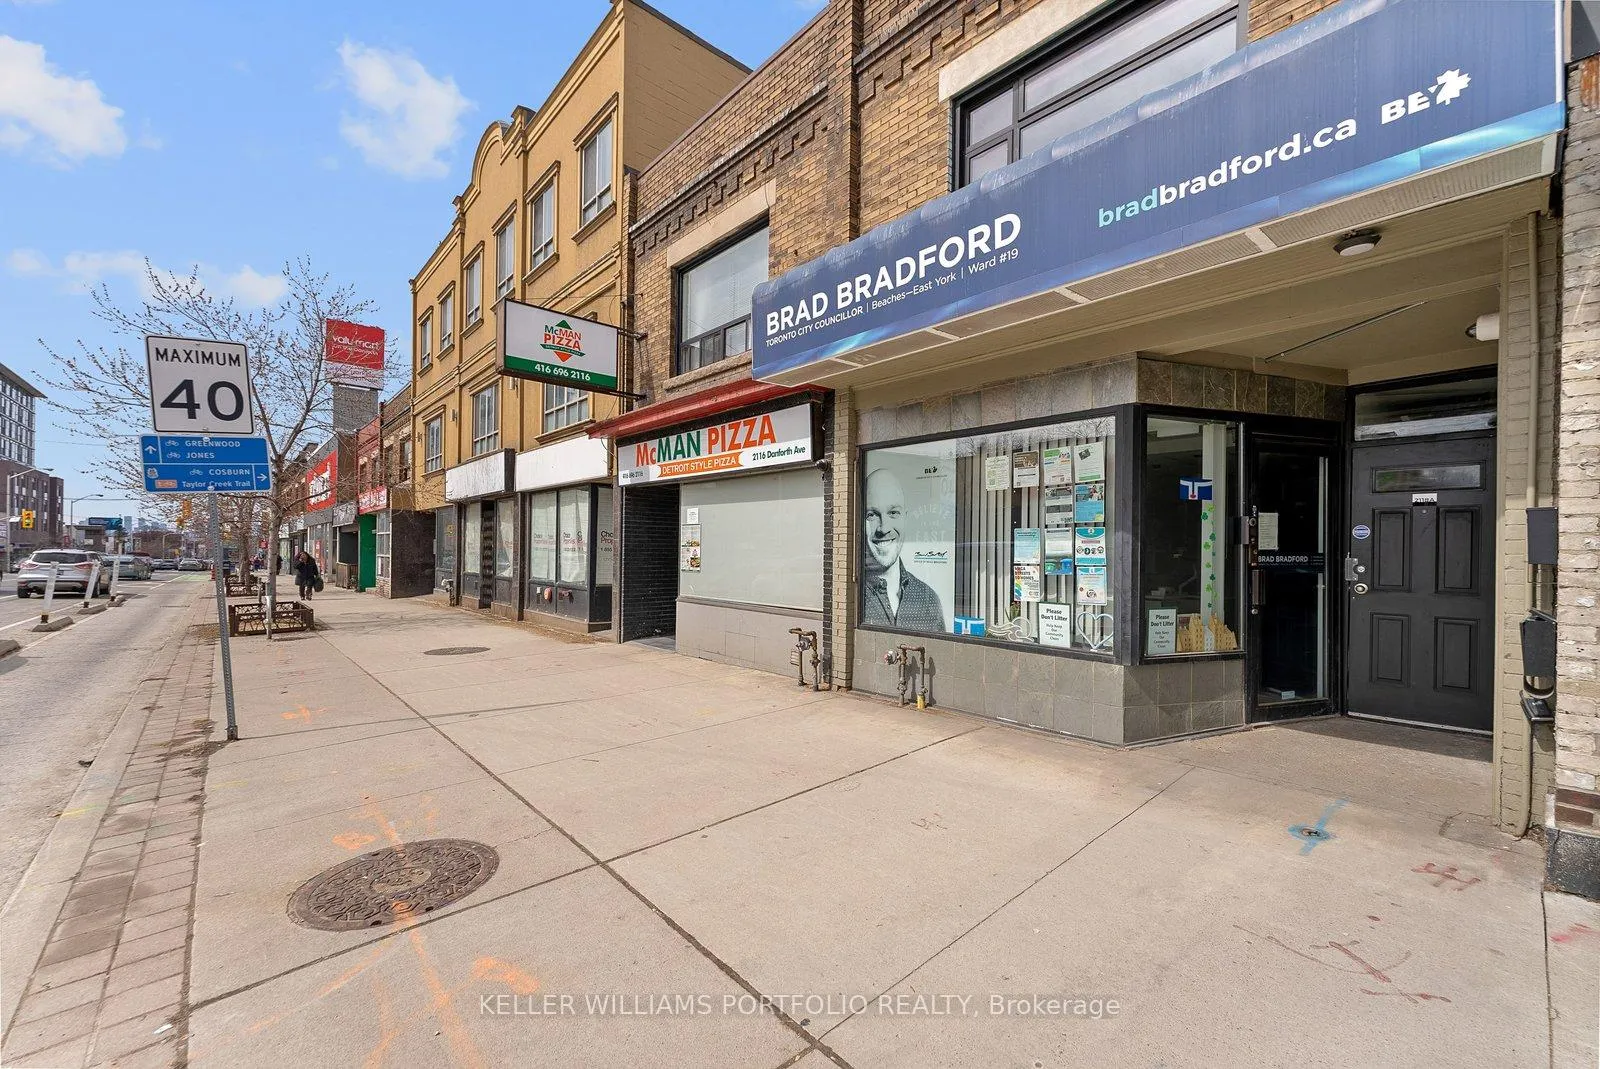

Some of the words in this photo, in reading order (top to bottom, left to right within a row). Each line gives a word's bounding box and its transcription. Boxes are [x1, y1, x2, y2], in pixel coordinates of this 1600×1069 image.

[1097, 118, 1357, 228] bradbradford.ca
[766, 292, 829, 336] BRAD
[836, 213, 1022, 309] BRADFORD
[765, 329, 798, 347] TORONTO
[797, 322, 814, 338] CITY
[814, 306, 864, 330] COUNCILLOR
[934, 271, 957, 286] York
[967, 257, 997, 275] Ward
[998, 248, 1020, 264] #19
[543, 333, 581, 351] PIZZA
[544, 325, 582, 341] McMAN
[155, 347, 241, 367] MAXIMUM
[534, 363, 551, 374] 416
[553, 367, 569, 377] 696
[570, 370, 591, 381] 2116
[160, 379, 244, 421] 40
[185, 440, 241, 448] GREENWOOD
[636, 430, 701, 467] McMAN
[707, 414, 777, 454] PIZZA
[752, 452, 766, 461] 2116
[767, 447, 793, 458] Danforth
[794, 446, 806, 454] Ave
[208, 468, 251, 476] COSBURN
[662, 464, 689, 475] DETROIT
[690, 460, 713, 471] STYLE
[713, 457, 737, 468] PIZZA
[182, 480, 206, 489] Taylor
[209, 480, 232, 488] Creek
[235, 480, 252, 488] Trail
[1258, 555, 1275, 563] BRAD
[1275, 555, 1309, 563] BRADFORD
